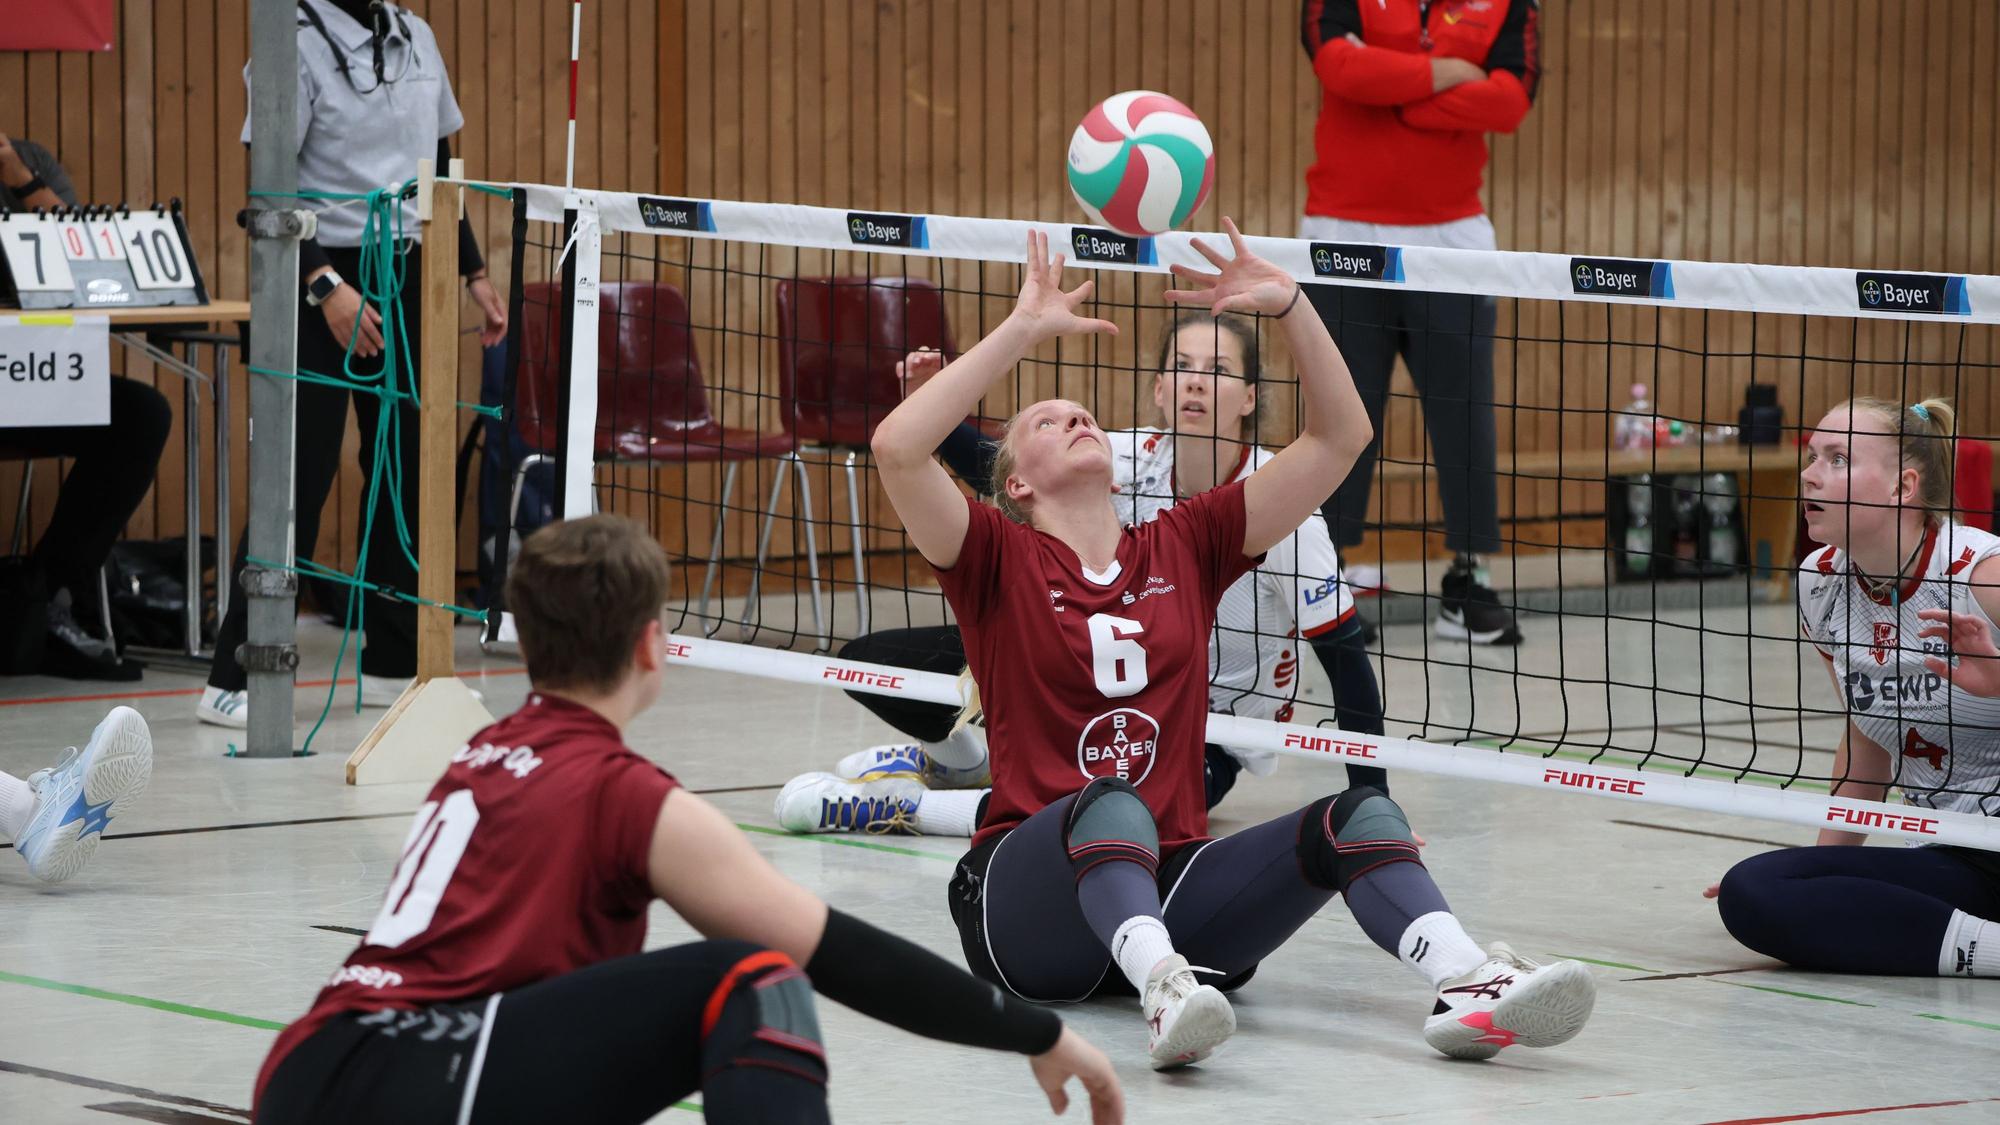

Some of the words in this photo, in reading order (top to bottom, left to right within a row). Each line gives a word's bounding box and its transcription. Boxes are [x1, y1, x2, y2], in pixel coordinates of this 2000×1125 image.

[656, 206, 688, 225] Bayer
[866, 221, 901, 242] Bayer
[18, 232, 46, 285] 7
[66, 227, 84, 256] 0
[101, 228, 115, 256] 1
[131, 229, 182, 282] 10
[1091, 237, 1126, 258] Bayer
[1332, 252, 1372, 274] Bayer
[1595, 268, 1637, 291] Bayer
[1883, 283, 1930, 307] Bayer
[68, 353, 84, 381] 3
[1086, 612, 1149, 699] 6
[823, 666, 905, 690] FUNTEC
[1879, 672, 1942, 702] EWP
[1085, 740, 1154, 762] BAYER
[1285, 733, 1378, 759] FUNTEC
[1903, 727, 1949, 771] 4
[1543, 769, 1646, 796] FUNTEC
[1826, 806, 1940, 835] FUNTEC
